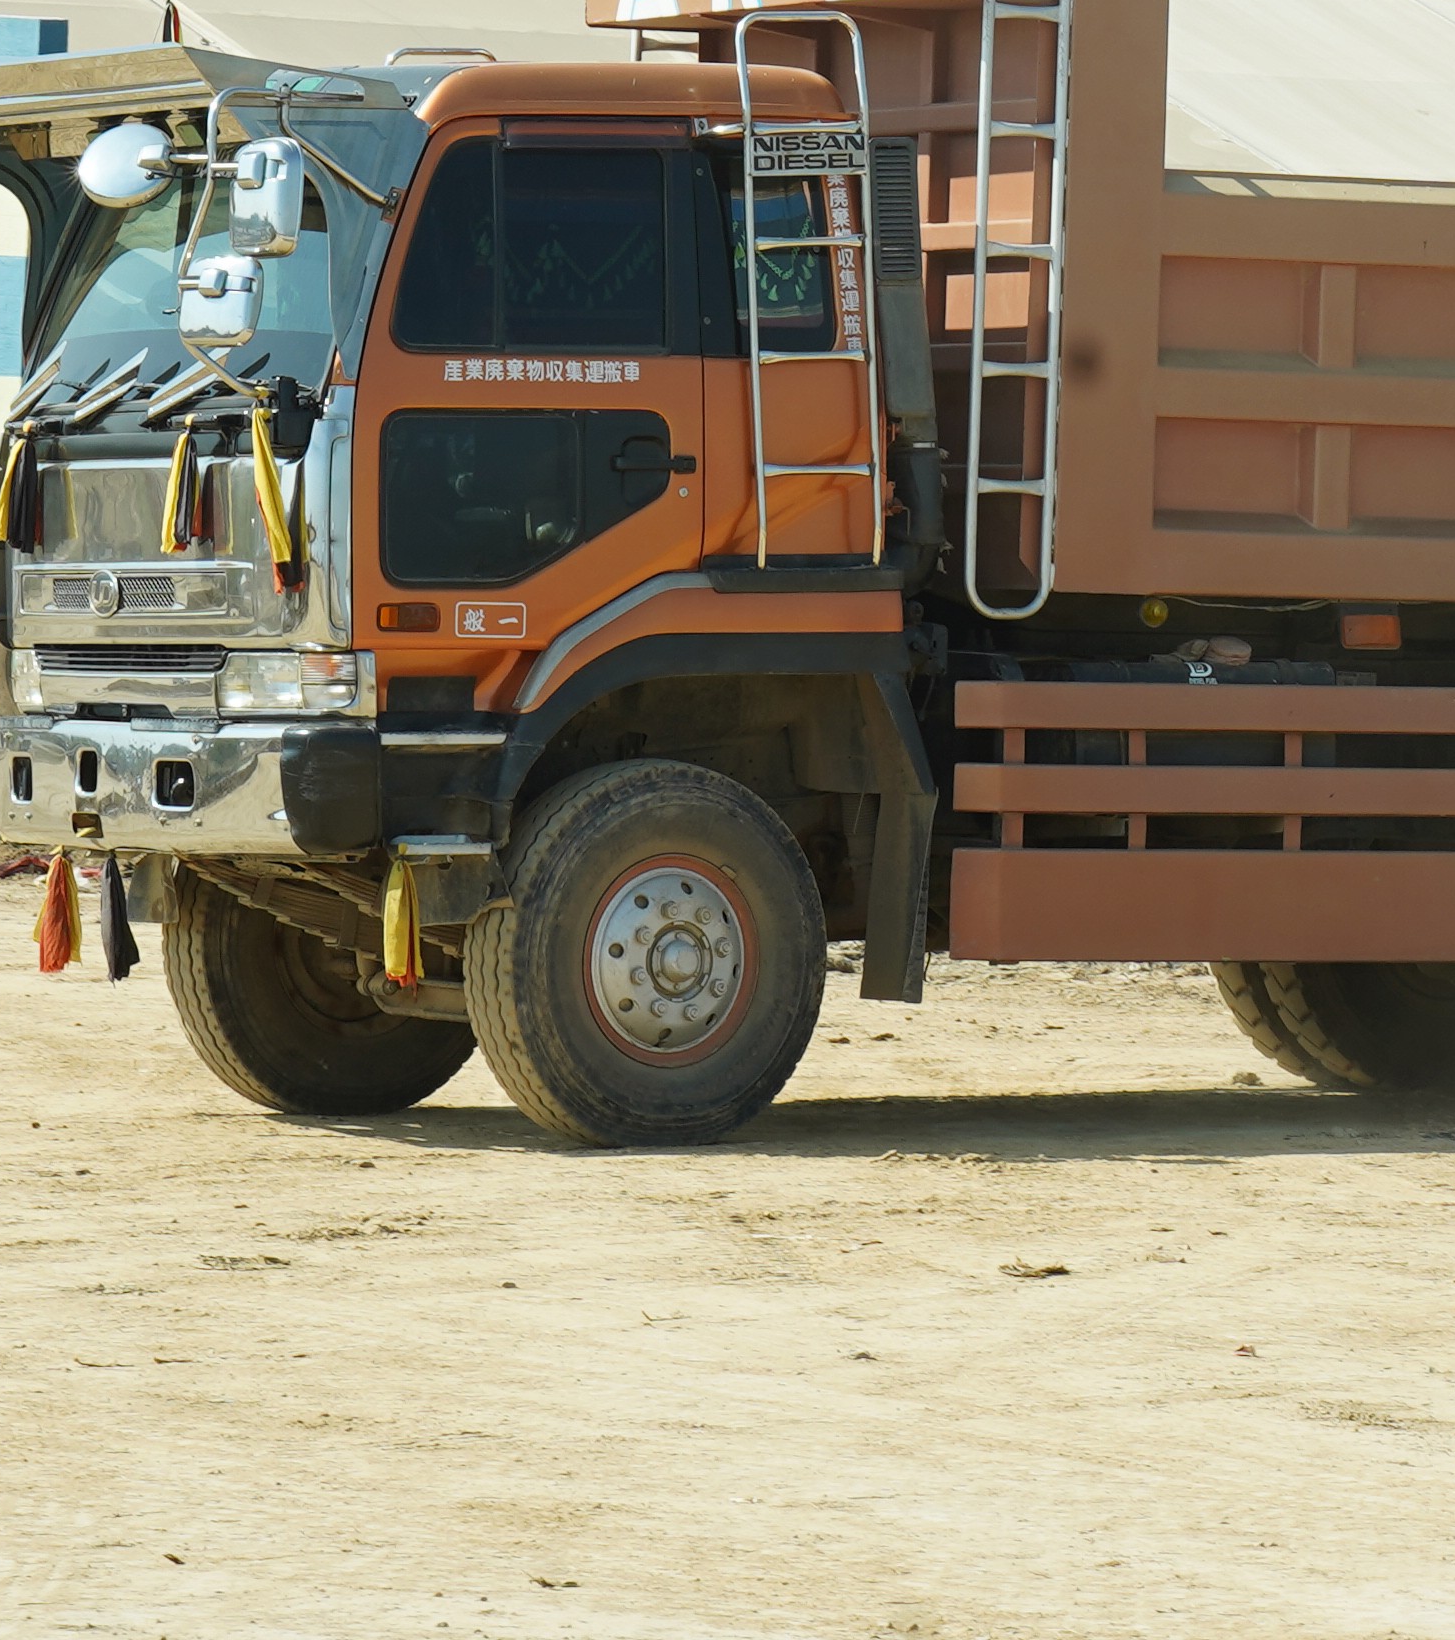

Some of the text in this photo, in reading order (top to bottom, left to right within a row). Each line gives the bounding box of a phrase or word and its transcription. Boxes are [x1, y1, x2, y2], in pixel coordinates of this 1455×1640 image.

[753, 135, 865, 153] NISSAN
[753, 153, 866, 171] DIESEL
[443, 358, 641, 384] 産業廃棄物収集運搬車
